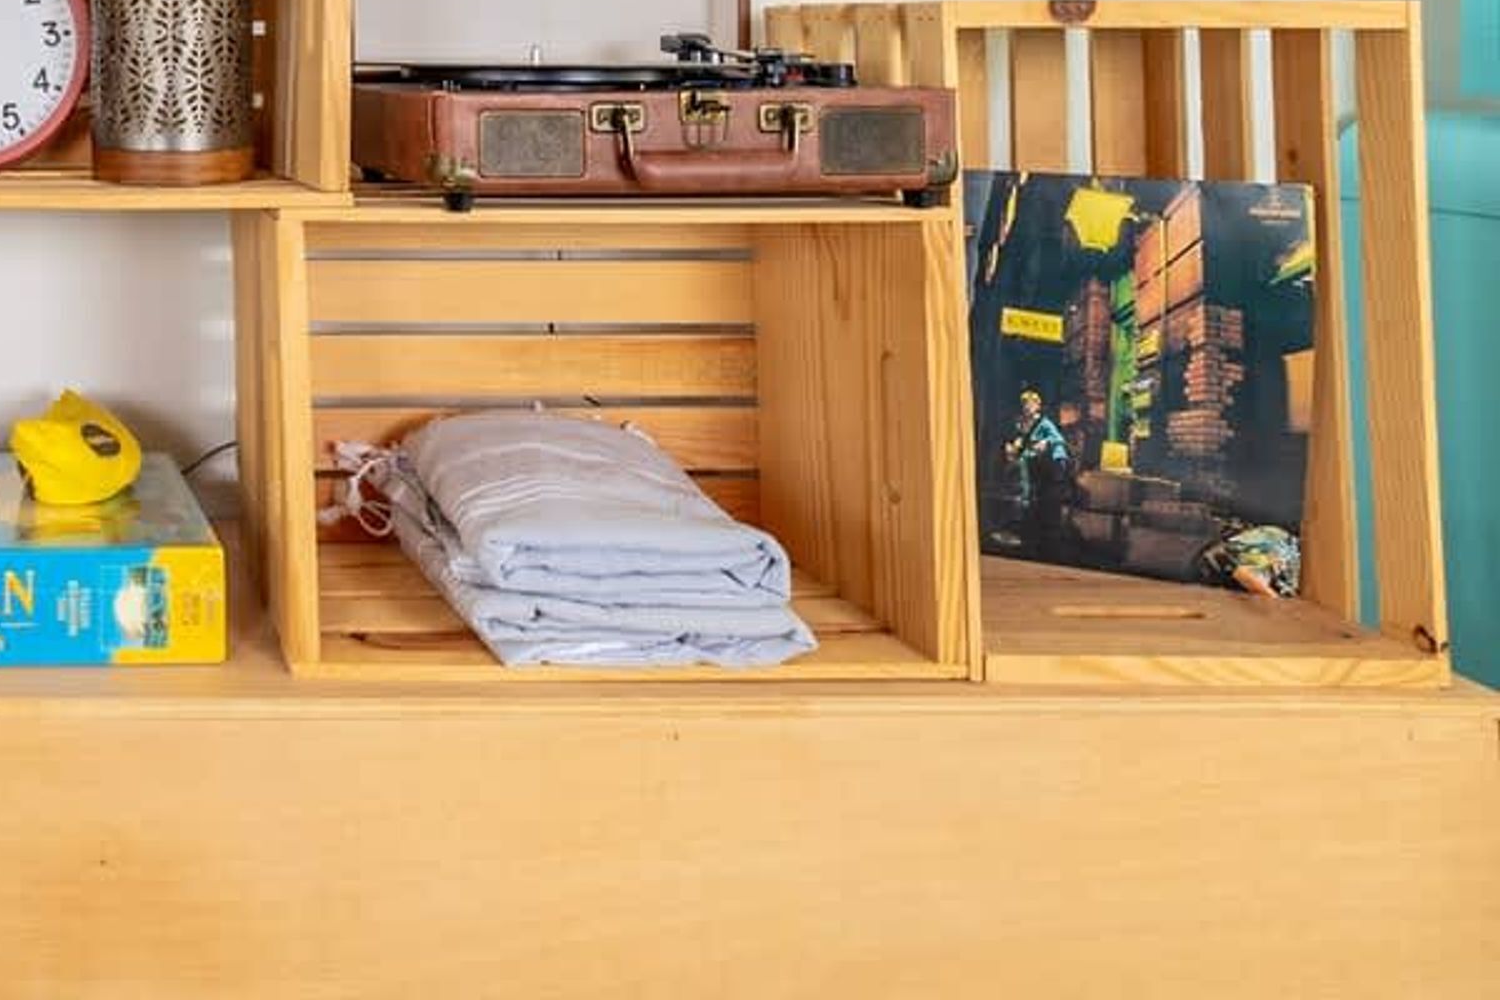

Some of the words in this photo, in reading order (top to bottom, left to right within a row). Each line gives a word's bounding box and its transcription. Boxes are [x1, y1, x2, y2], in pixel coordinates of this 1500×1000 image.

[41, 21, 61, 47] 3
[32, 67, 51, 94] 4
[2, 103, 21, 131] 5
